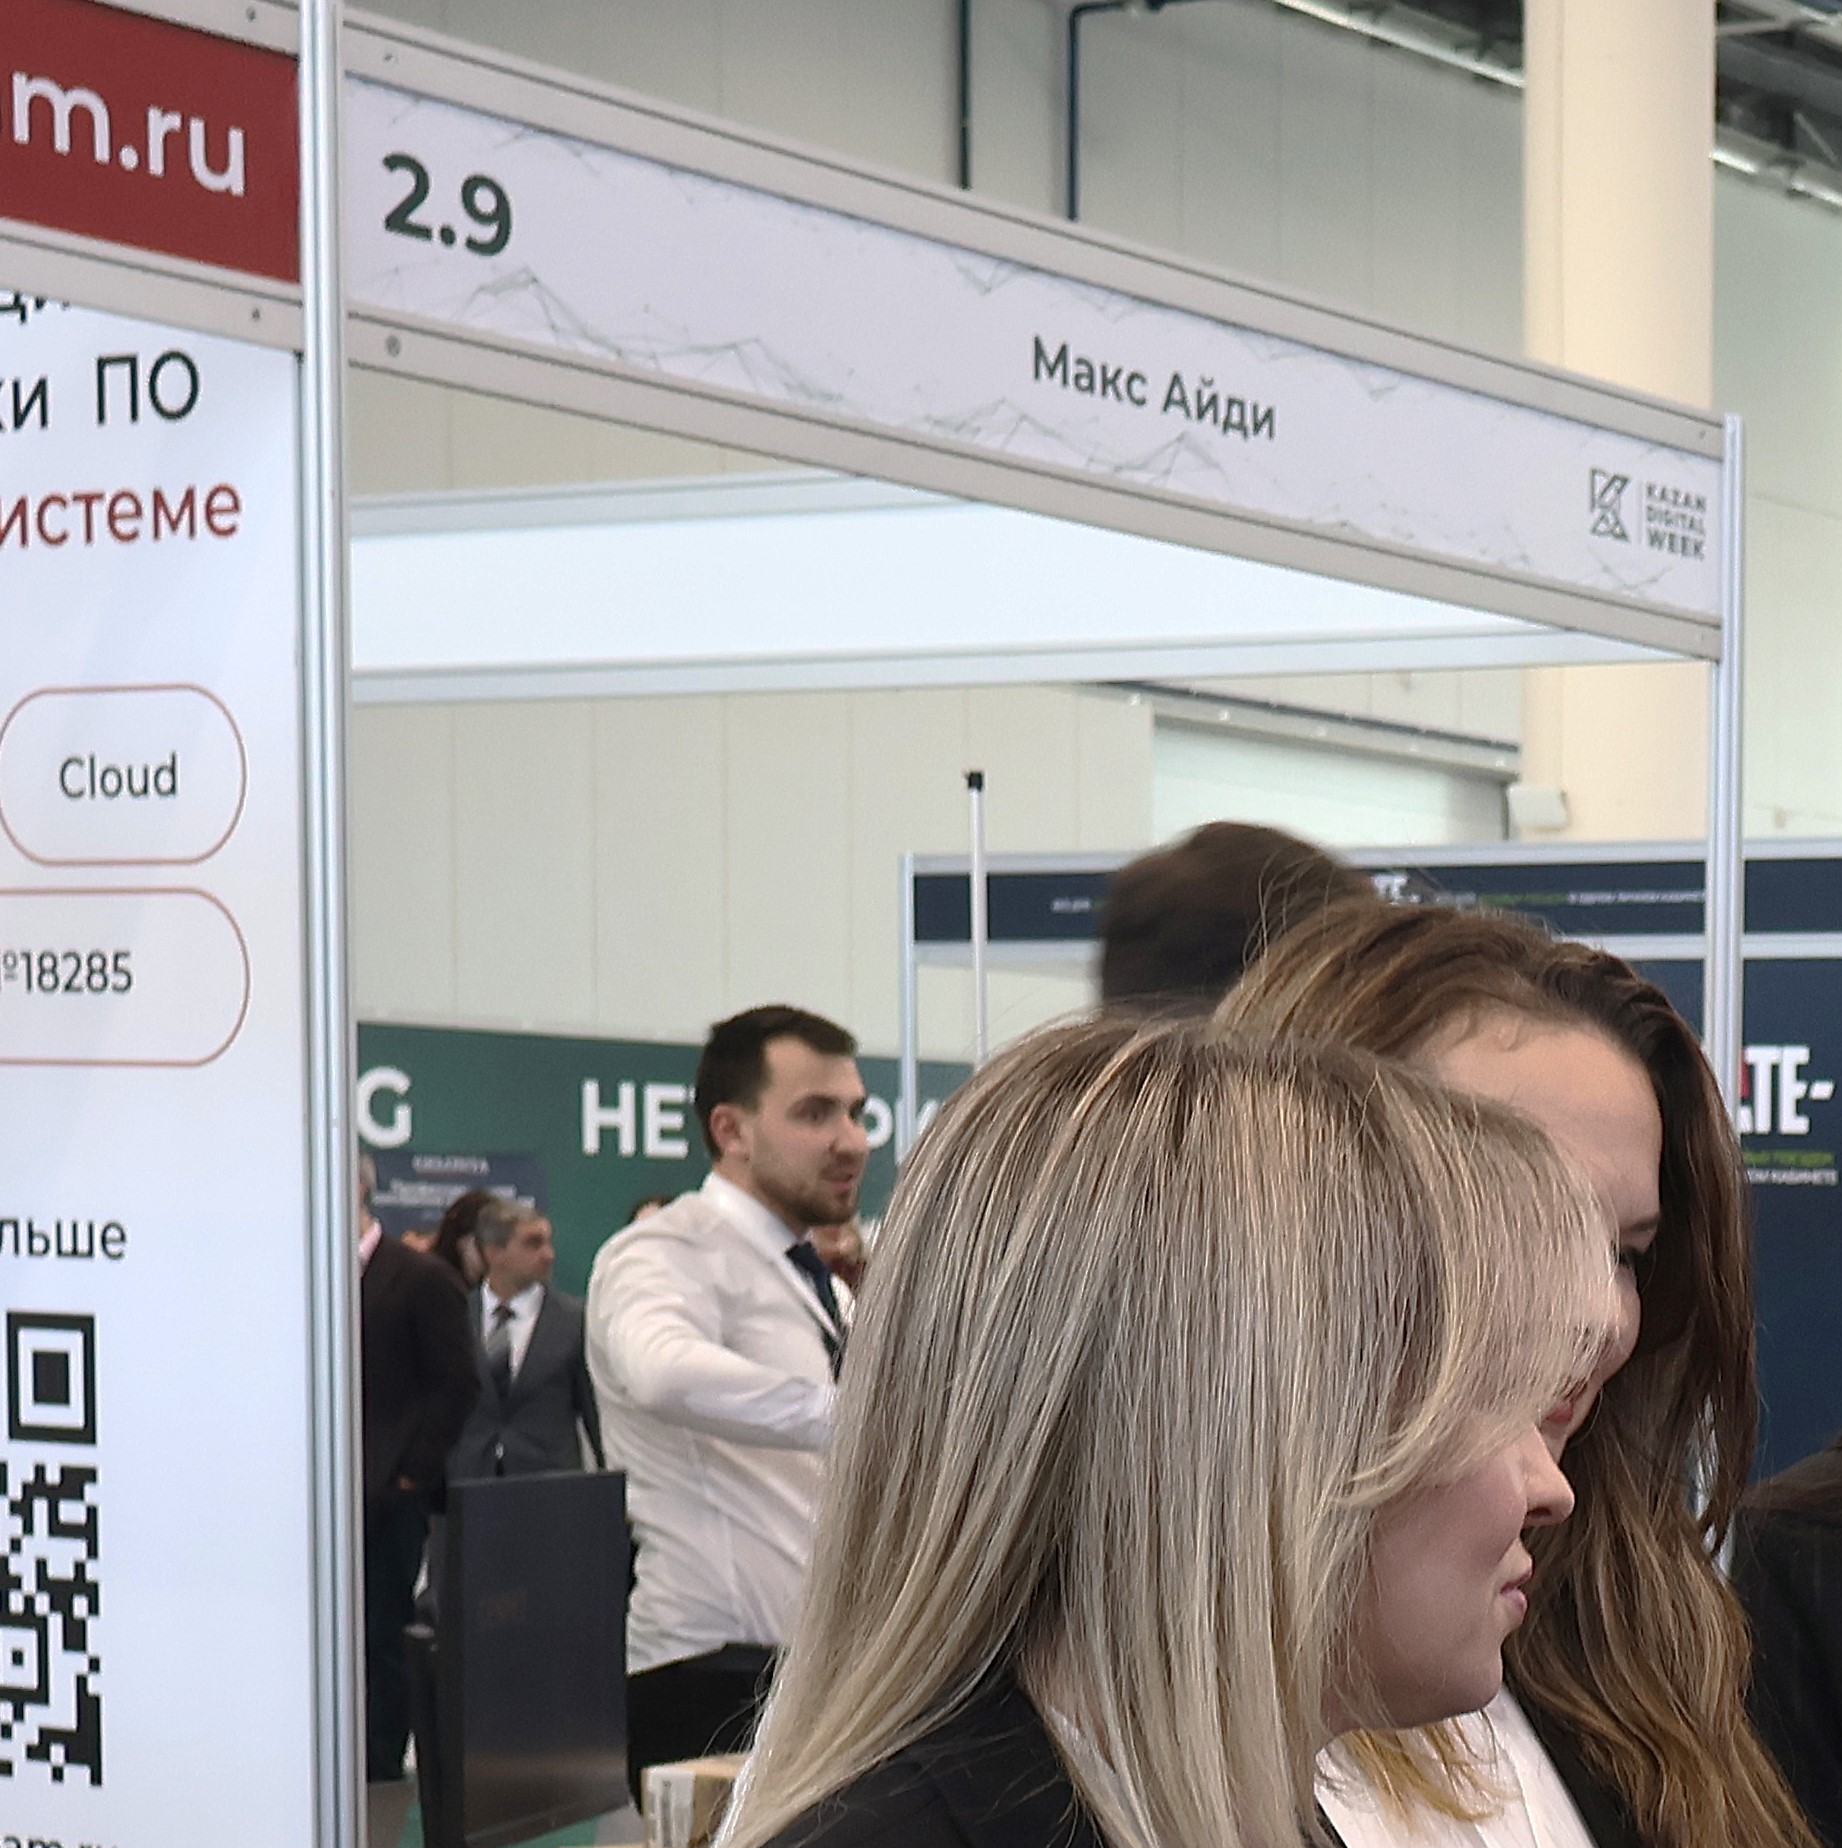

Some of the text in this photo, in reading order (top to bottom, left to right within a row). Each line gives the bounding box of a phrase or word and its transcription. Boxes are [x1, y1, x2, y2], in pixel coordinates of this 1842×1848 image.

[381, 152, 512, 256] 2.9
[97, 350, 200, 424] ПО
[1033, 336, 1277, 442] Макс Айди
[1646, 482, 1706, 513] KAZAN
[1646, 504, 1705, 537] DIGITAL
[1647, 528, 1705, 560] WEEK
[59, 752, 179, 799] Cloud
